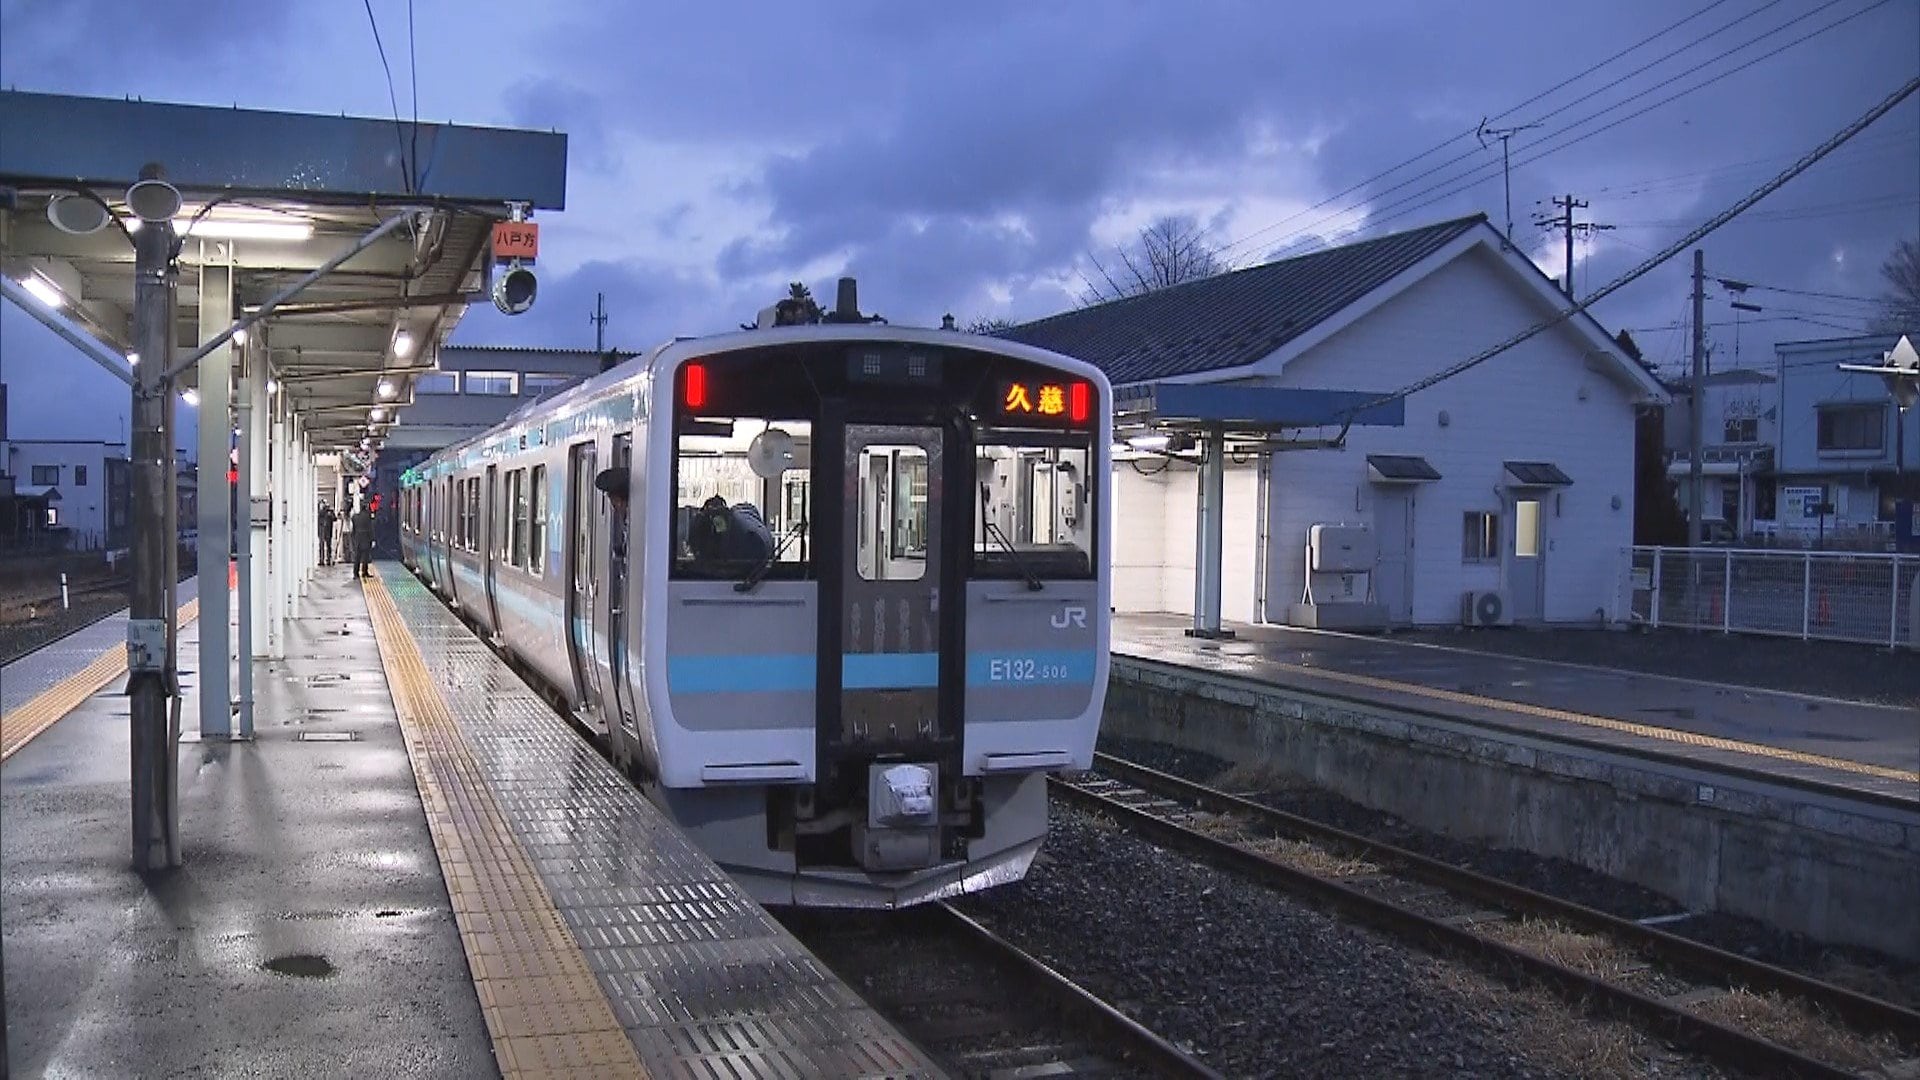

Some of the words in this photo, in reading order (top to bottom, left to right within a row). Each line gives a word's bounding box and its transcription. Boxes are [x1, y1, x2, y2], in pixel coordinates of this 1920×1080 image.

[497, 230, 535, 247] 八戸方
[1005, 384, 1064, 414] 久慈
[1051, 607, 1087, 628] JR
